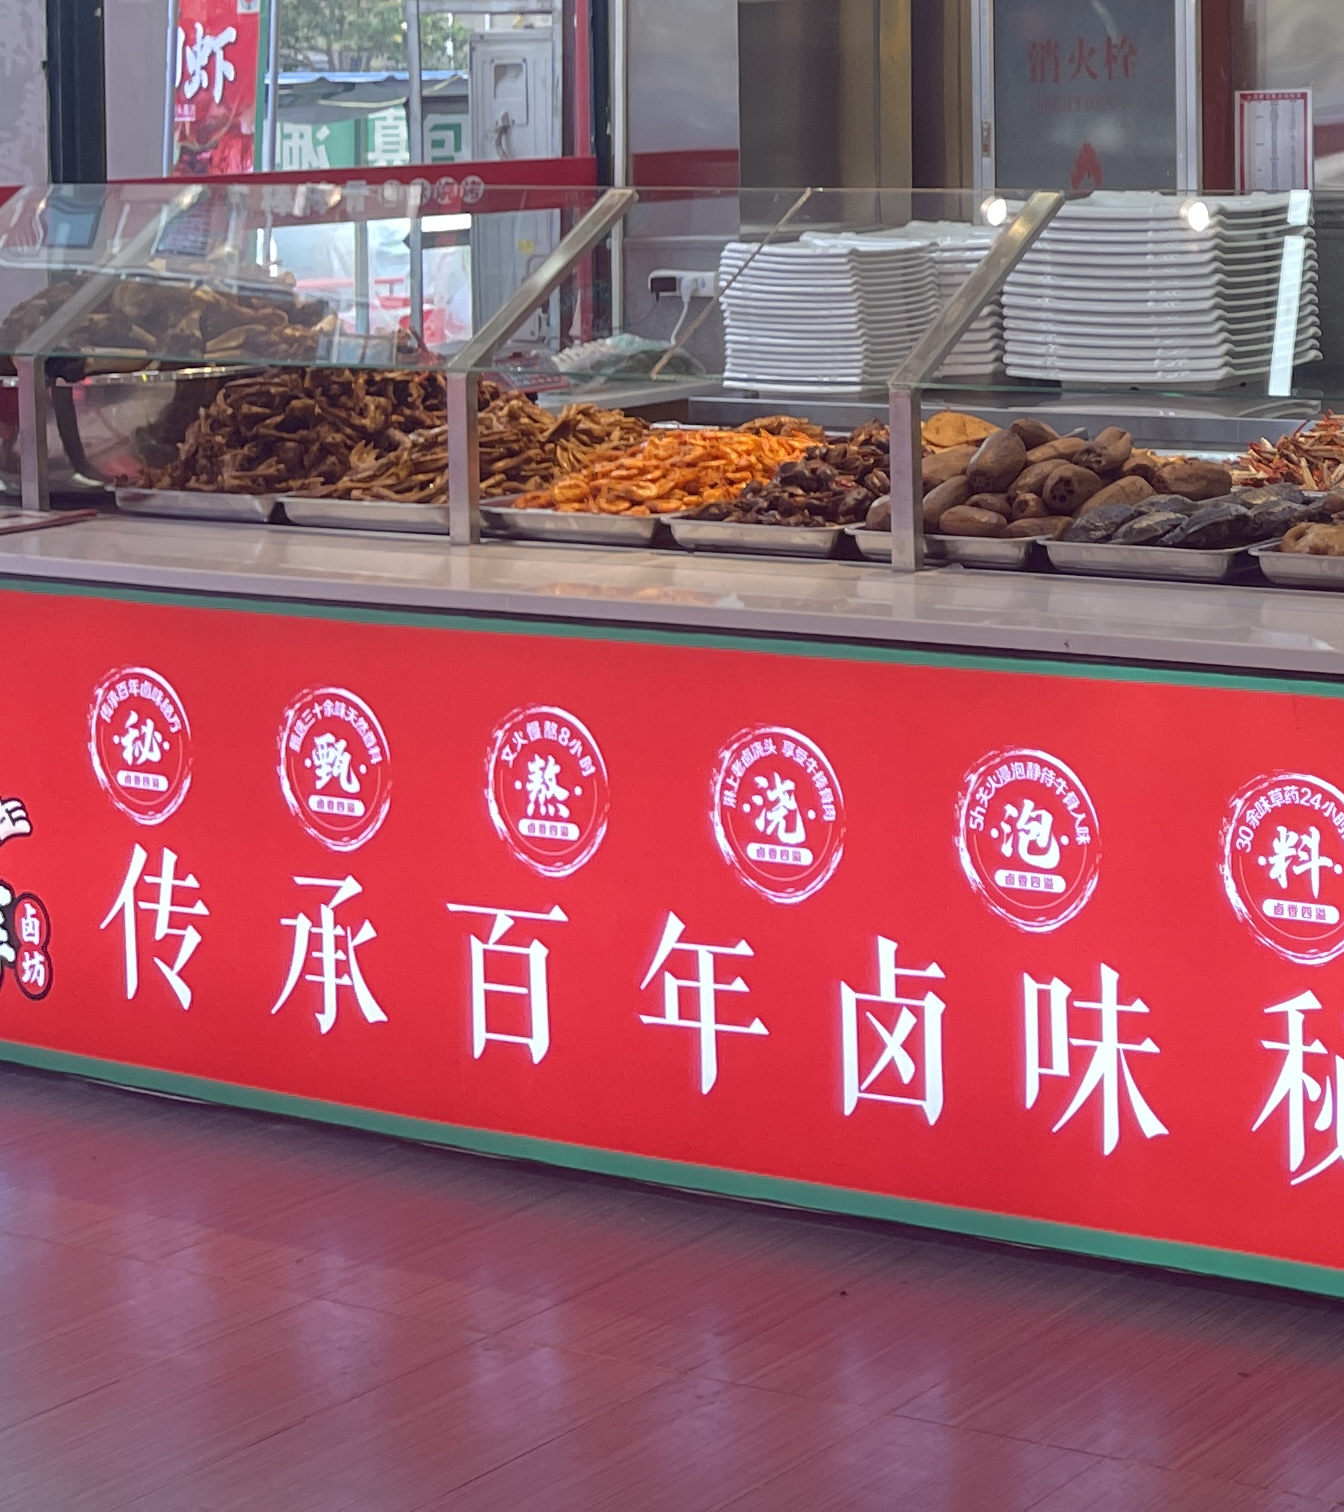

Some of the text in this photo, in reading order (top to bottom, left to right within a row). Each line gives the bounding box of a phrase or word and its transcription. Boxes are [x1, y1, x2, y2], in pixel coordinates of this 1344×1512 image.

[1028, 35, 1138, 84] 消火栓
[120, 709, 162, 765] 秘
[313, 733, 360, 793] 甄
[526, 753, 570, 818] 熬
[745, 772, 806, 844] 浇
[1000, 799, 1060, 869] 泡
[1268, 825, 1333, 899] 料
